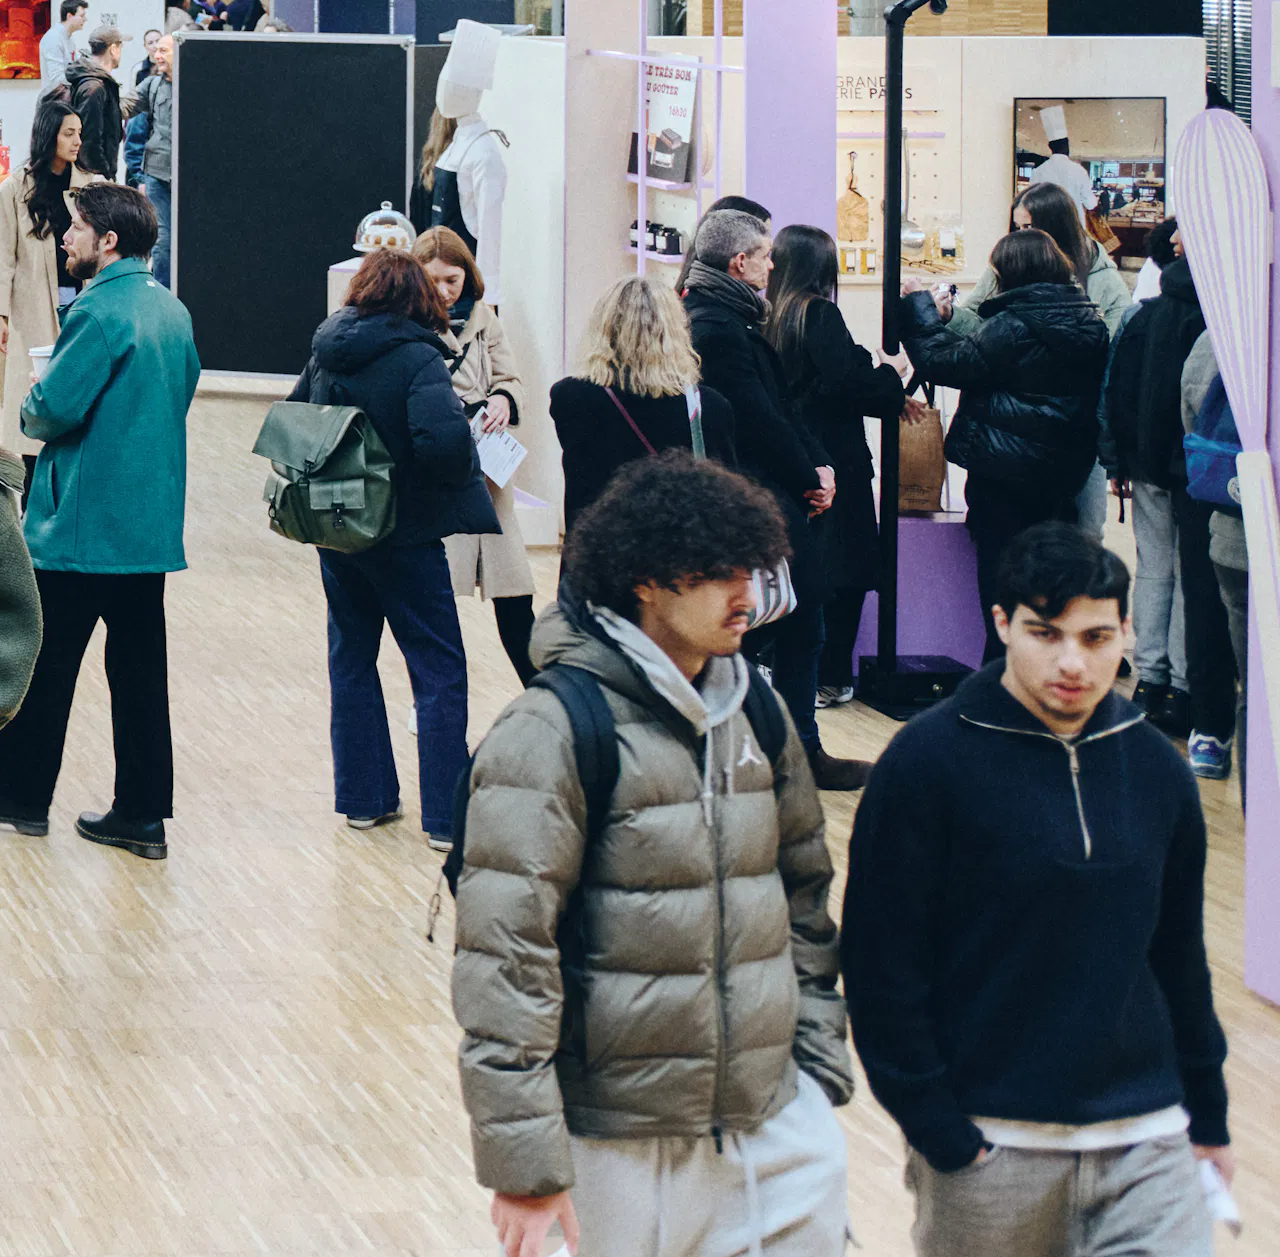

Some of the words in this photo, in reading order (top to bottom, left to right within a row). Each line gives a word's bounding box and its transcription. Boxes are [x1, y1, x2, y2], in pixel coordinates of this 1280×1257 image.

[836, 76, 887, 88] GRAND
[836, 88, 862, 99] RIE
[869, 88, 913, 99] PAS
